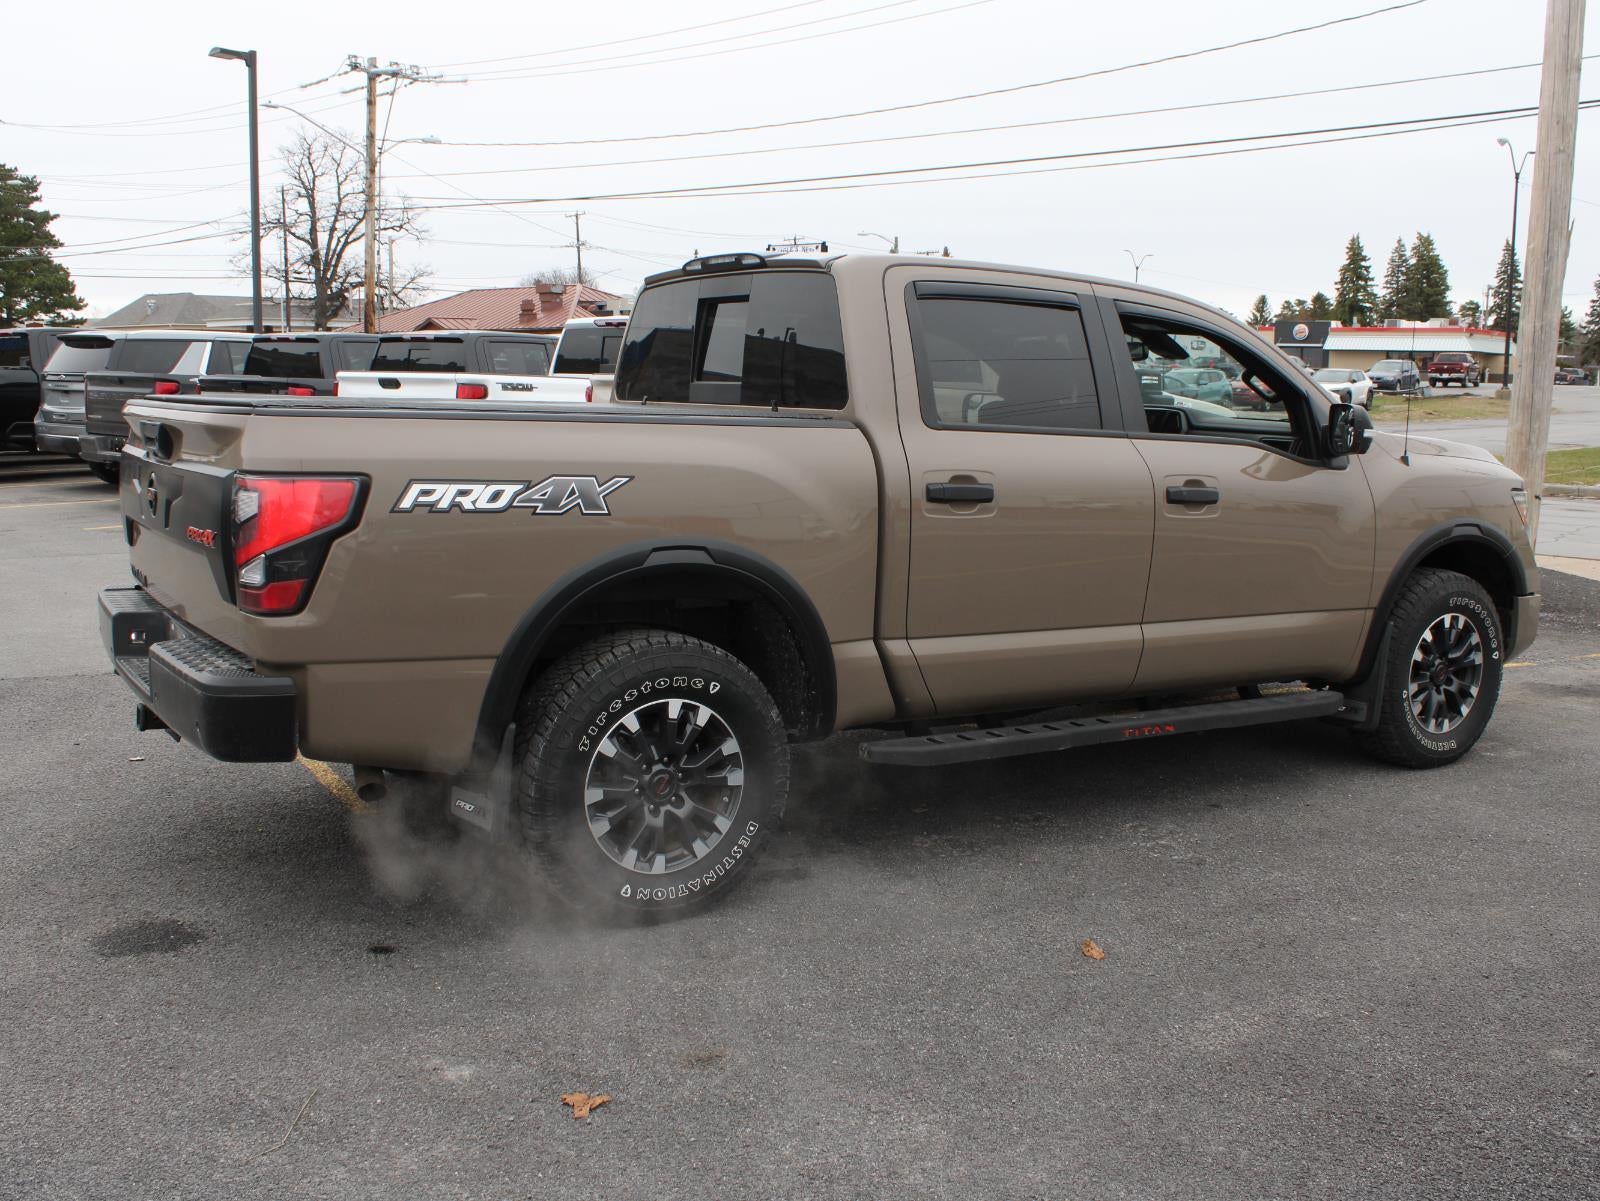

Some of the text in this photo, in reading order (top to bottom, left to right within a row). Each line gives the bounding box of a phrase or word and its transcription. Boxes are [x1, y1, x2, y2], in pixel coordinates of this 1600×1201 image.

[389, 474, 635, 516] PRO4X
[1123, 724, 1176, 737] TITAN
[636, 820, 759, 901] DESTINATION
